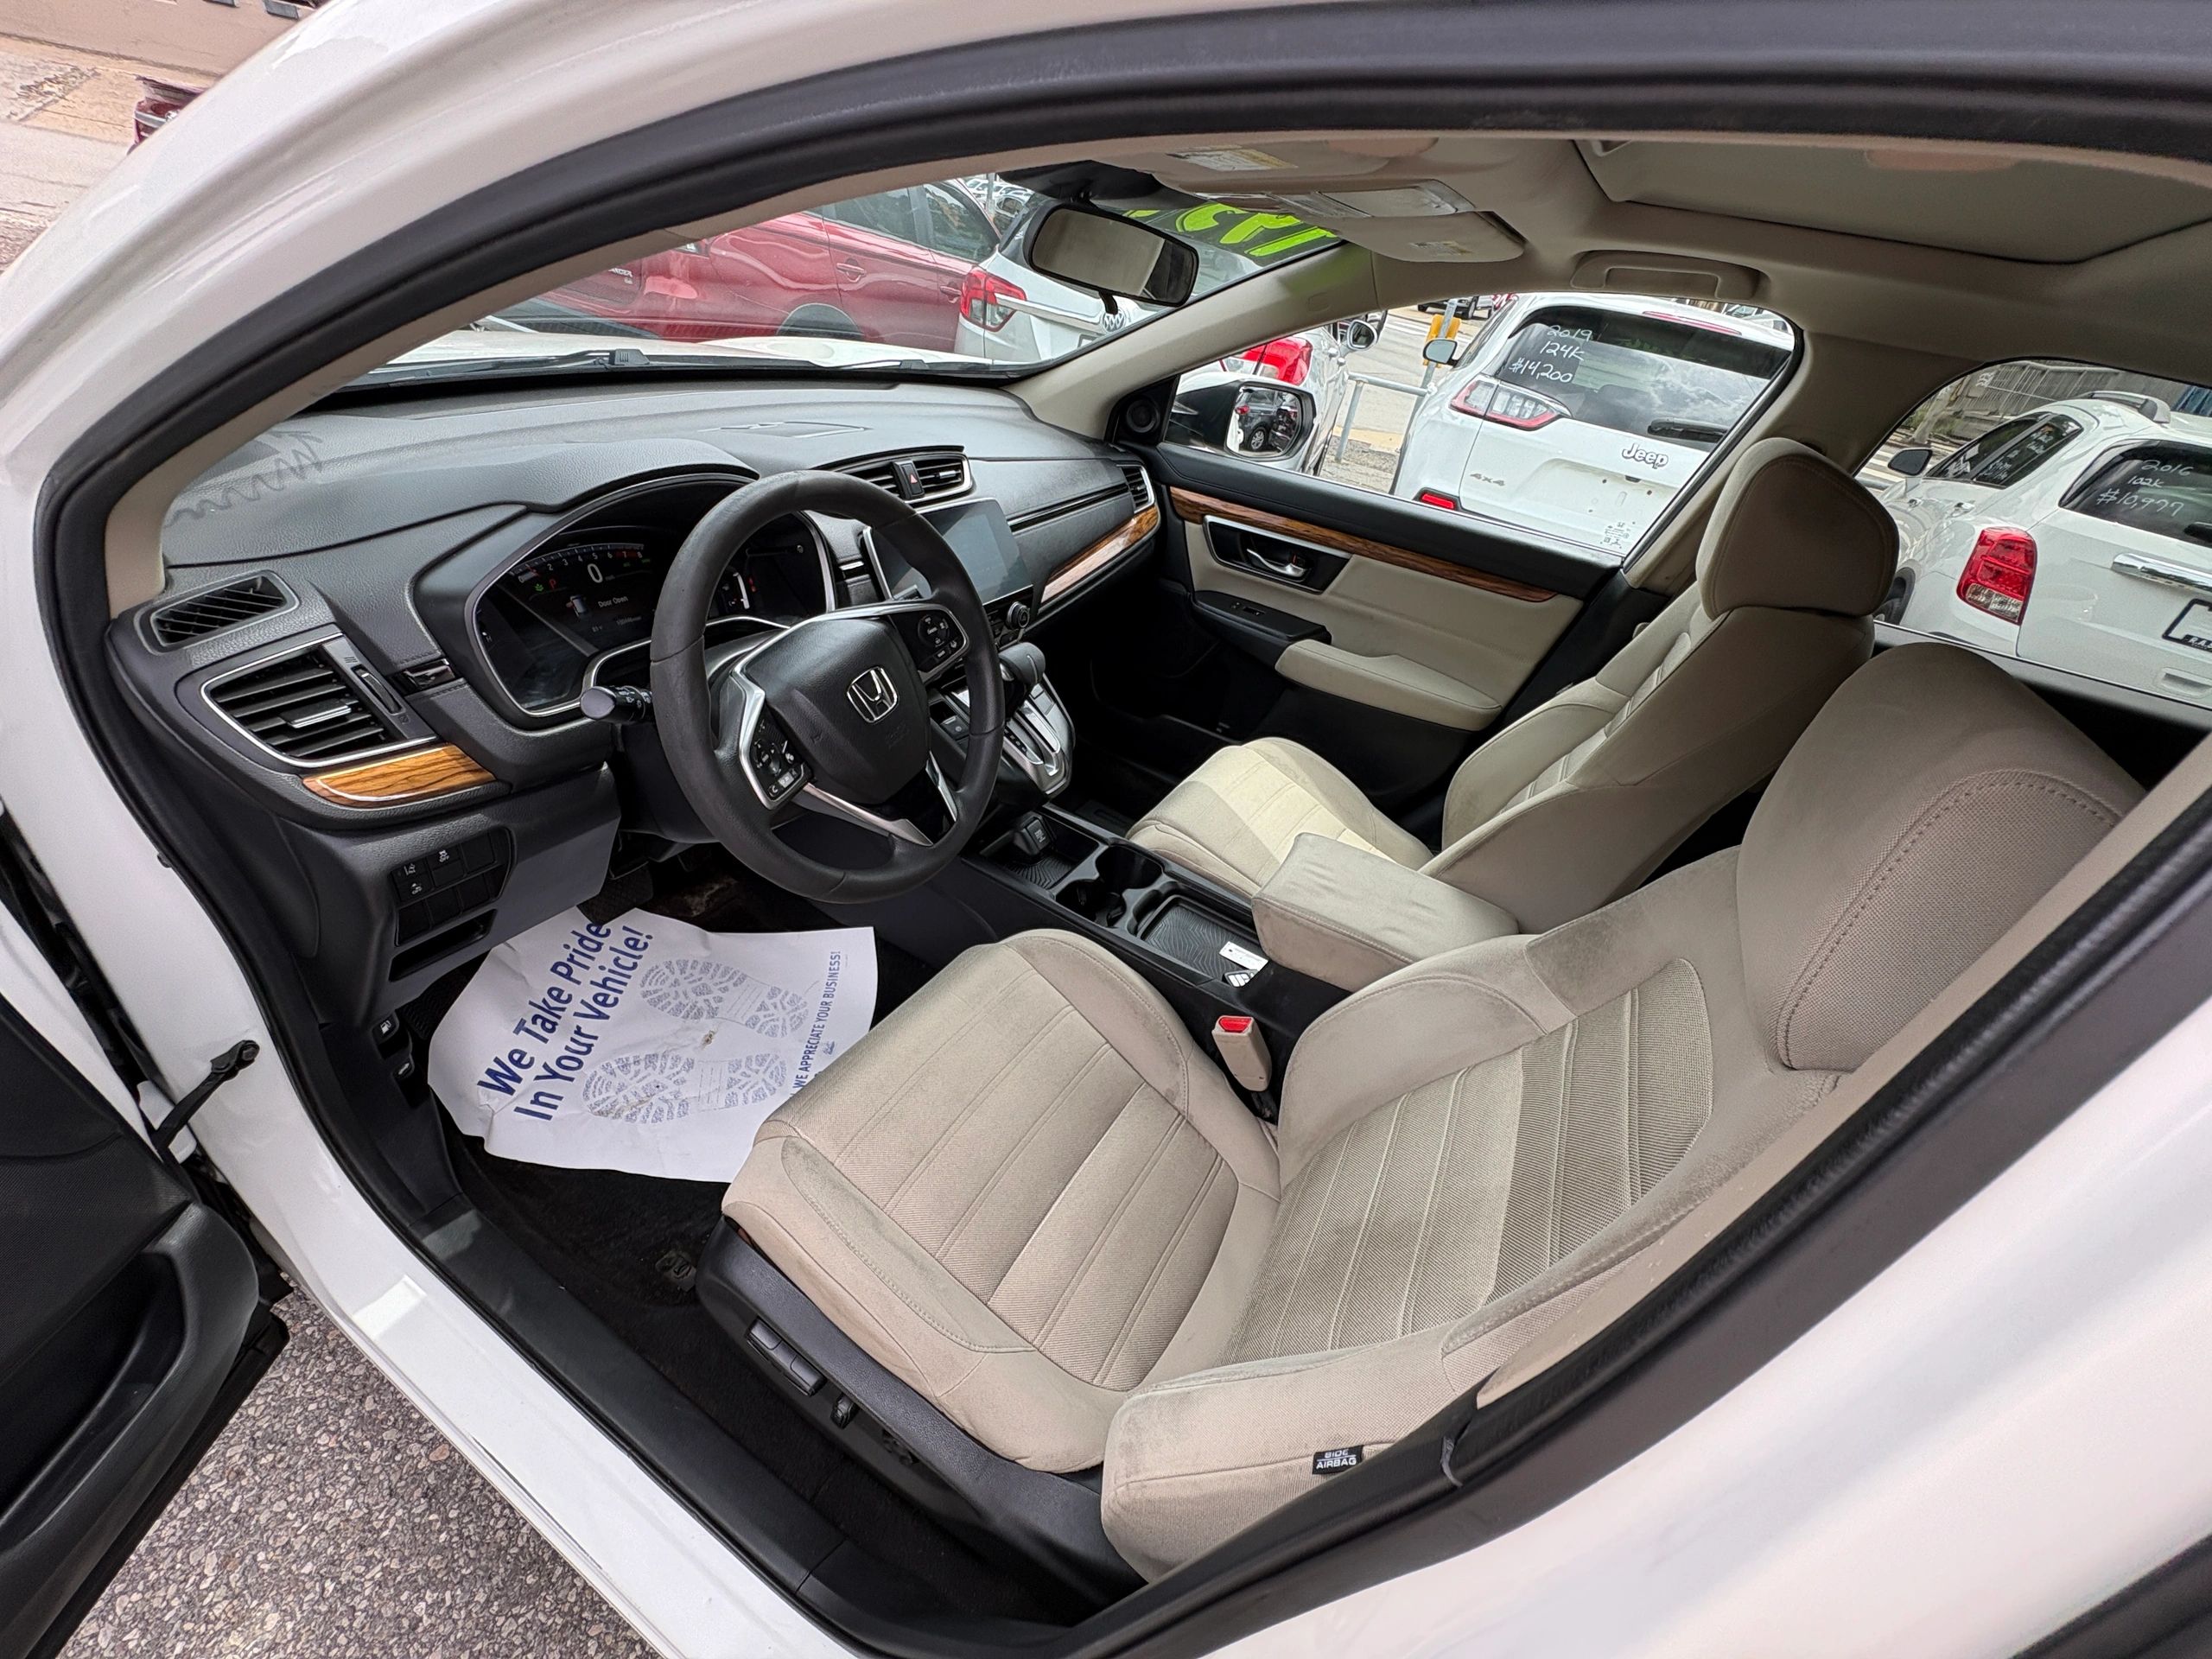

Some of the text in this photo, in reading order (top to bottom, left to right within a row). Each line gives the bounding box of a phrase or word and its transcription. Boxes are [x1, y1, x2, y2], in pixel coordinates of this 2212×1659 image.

[1547, 325, 1592, 342] 2019
[1540, 340, 1585, 361] 124K
[1622, 442, 1669, 469] Jeep
[2141, 459, 2195, 476] 2016
[587, 563, 603, 583] 0
[549, 578, 557, 589] P
[598, 595, 629, 608] Door Open
[823, 950, 842, 999] BUSINESS!
[477, 921, 612, 1096] We Take Pride
[816, 1000, 833, 1026] YOUR
[513, 925, 653, 1122] In Your Vehicle!
[800, 1020, 825, 1072] APPRECIATE
[792, 1074, 809, 1089] WE
[1316, 1458, 1357, 1469] AIRBAG
[1325, 1449, 1349, 1458] SIDE
